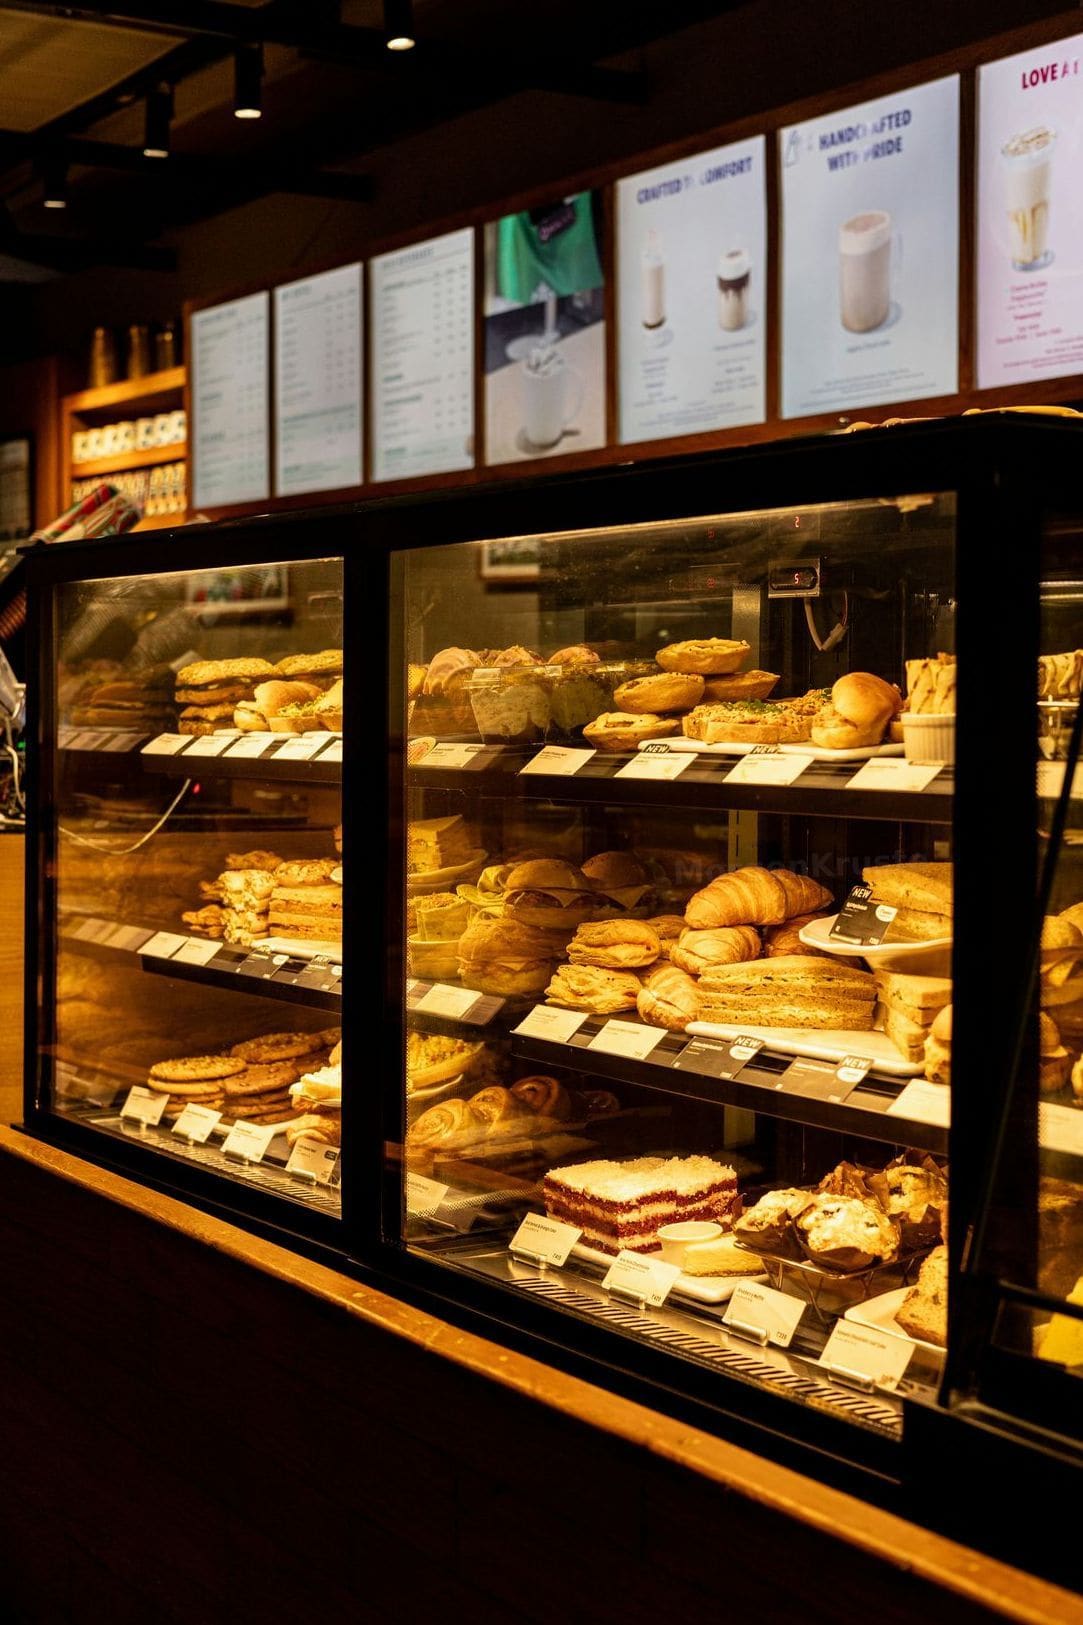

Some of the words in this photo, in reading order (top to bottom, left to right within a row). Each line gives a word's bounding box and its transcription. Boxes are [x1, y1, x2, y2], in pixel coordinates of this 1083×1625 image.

[1022, 62, 1058, 89] LOVE
[819, 109, 912, 150] HANDCAFTED
[646, 744, 669, 753] NEW
[851, 887, 872, 898] NEW
[734, 1036, 761, 1049] NEW
[843, 1056, 869, 1070] NEW
